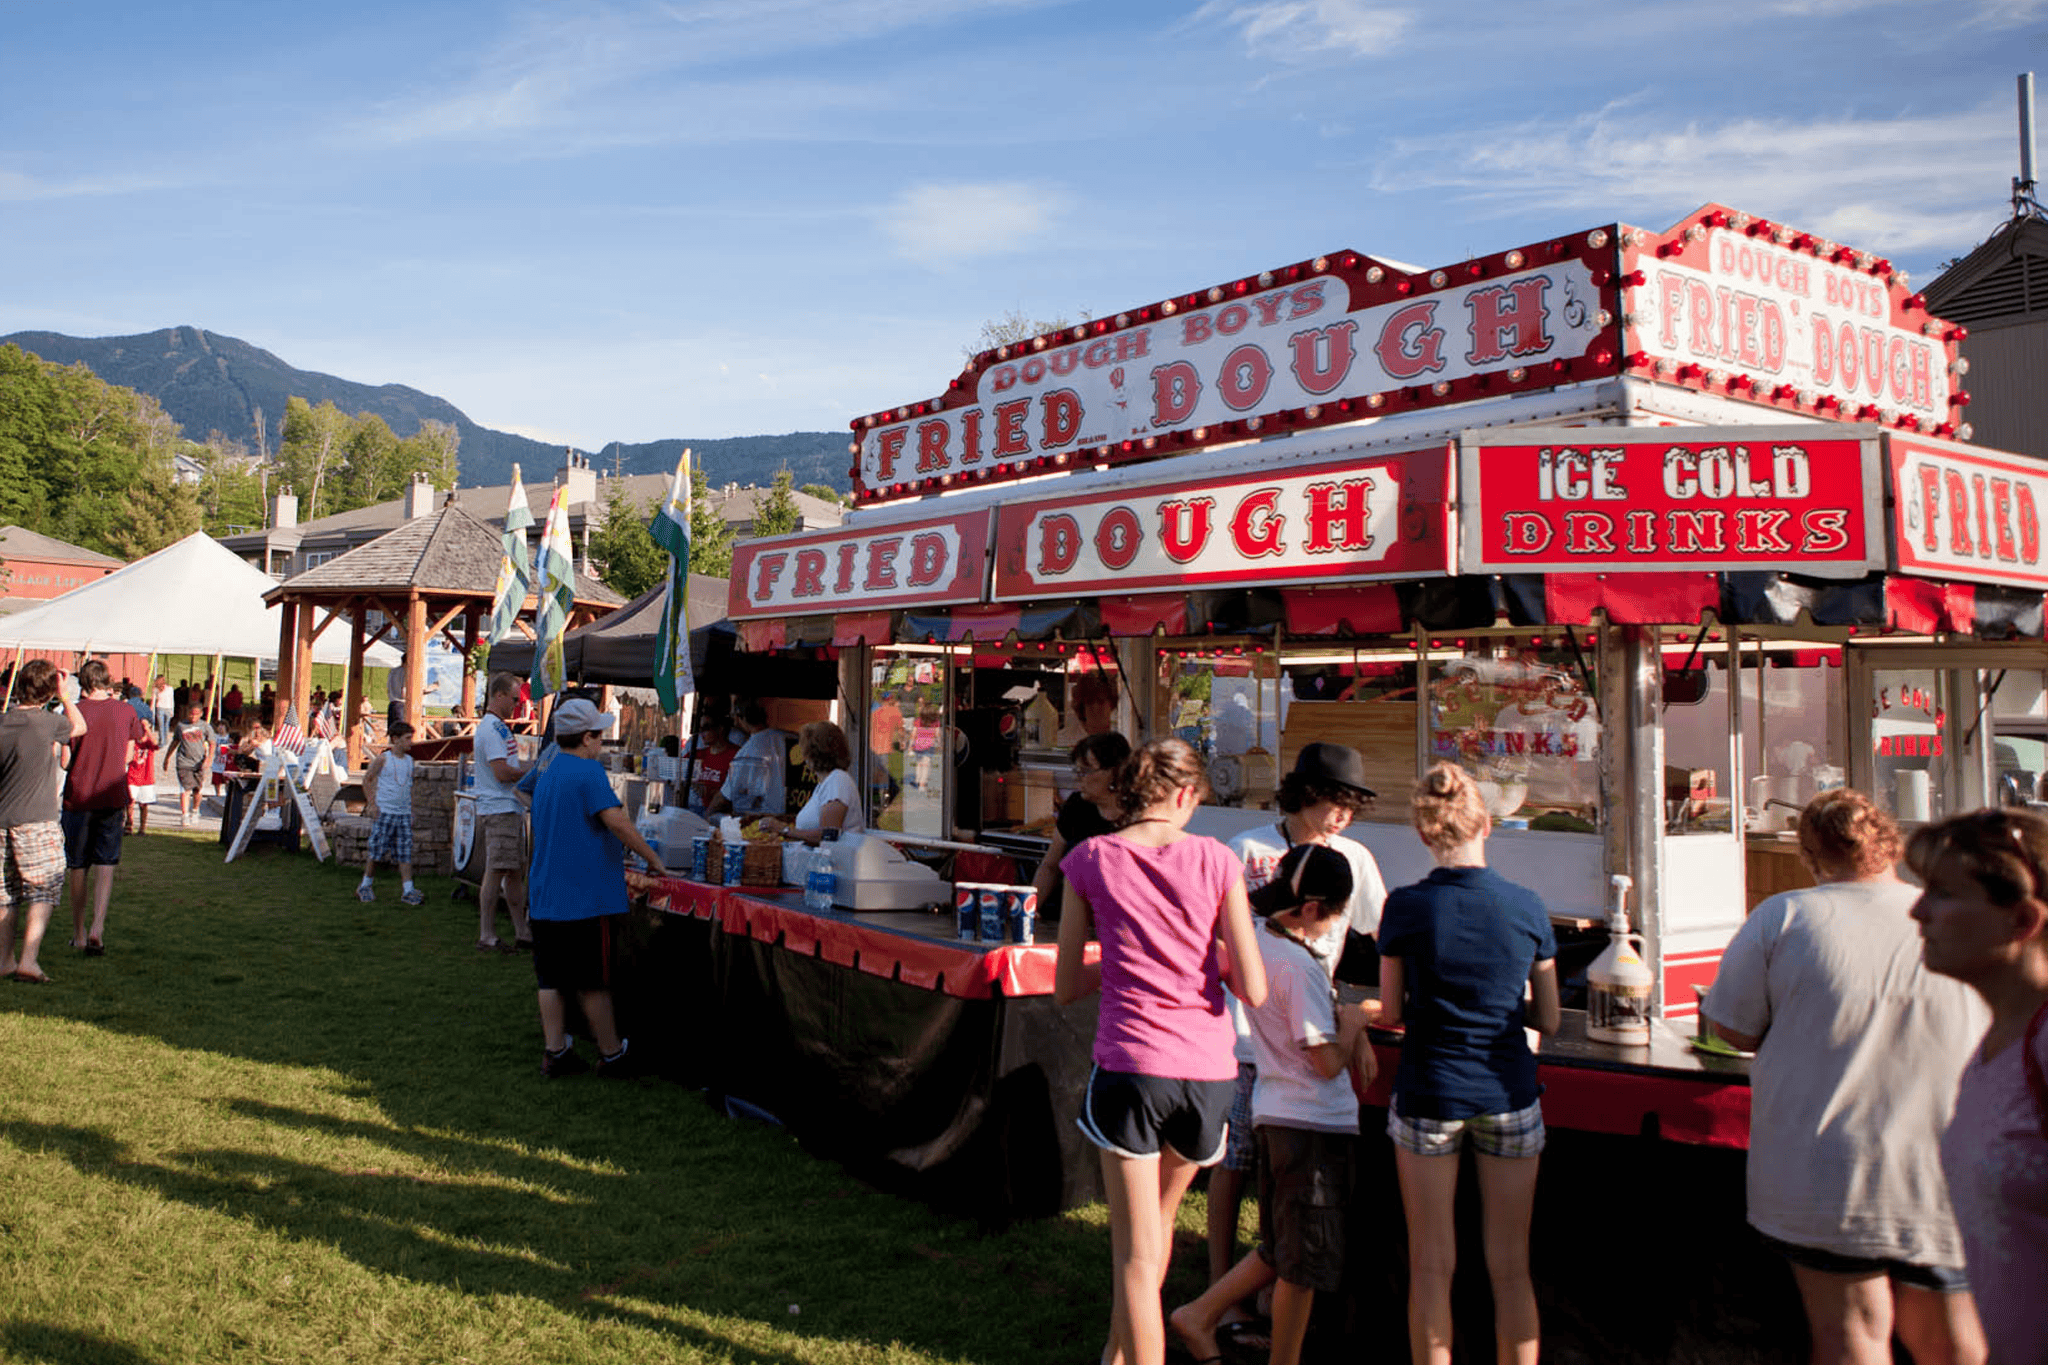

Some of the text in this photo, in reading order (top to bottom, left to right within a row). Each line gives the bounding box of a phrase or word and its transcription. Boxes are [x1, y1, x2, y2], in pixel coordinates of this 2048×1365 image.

[1719, 236, 1884, 319] DOUGH BOYS
[876, 274, 1554, 482] FRIED DOUGH
[991, 280, 1327, 393] DOUGH BOYS
[1656, 269, 1935, 412] FRIED DOUGH
[1537, 445, 1811, 501] ICE COLD
[1917, 461, 2040, 566] FRIED
[754, 478, 1377, 601] FRIED DOUGH
[1502, 507, 1852, 556] DRINKS
[1434, 730, 1579, 758] DRINKS
[1873, 734, 1944, 758] RINKS
